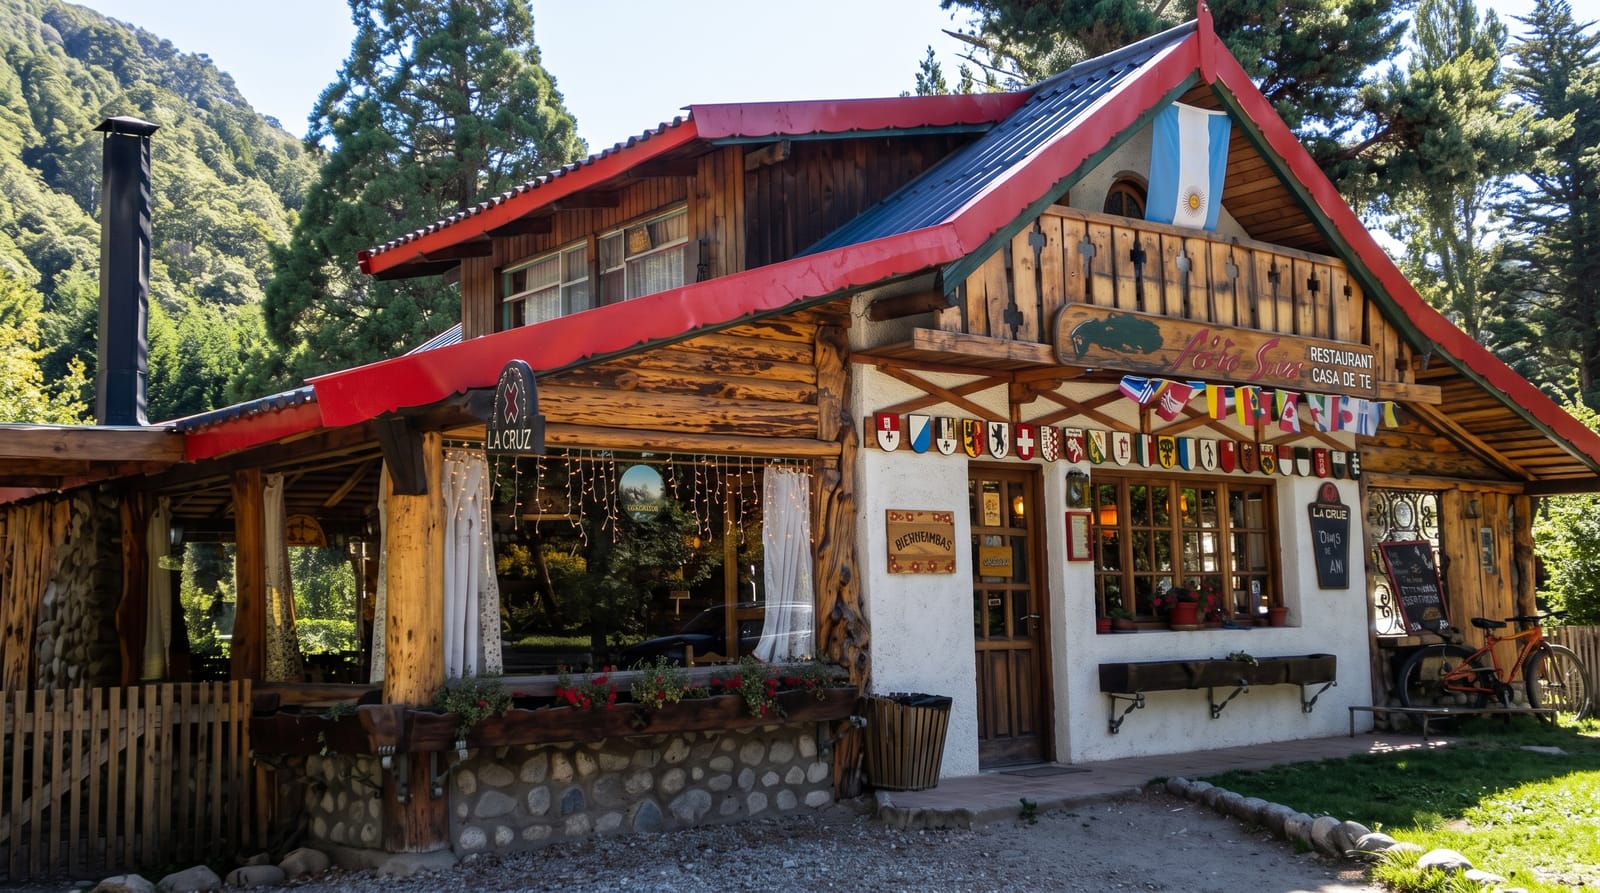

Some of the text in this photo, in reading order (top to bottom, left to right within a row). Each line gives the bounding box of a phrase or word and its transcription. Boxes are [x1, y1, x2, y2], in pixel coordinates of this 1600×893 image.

[1310, 346, 1374, 369] RESTAURANT
[1312, 367, 1372, 389] CASA DE TE
[487, 428, 532, 450] LA CRUZ
[1312, 507, 1324, 518] LA
